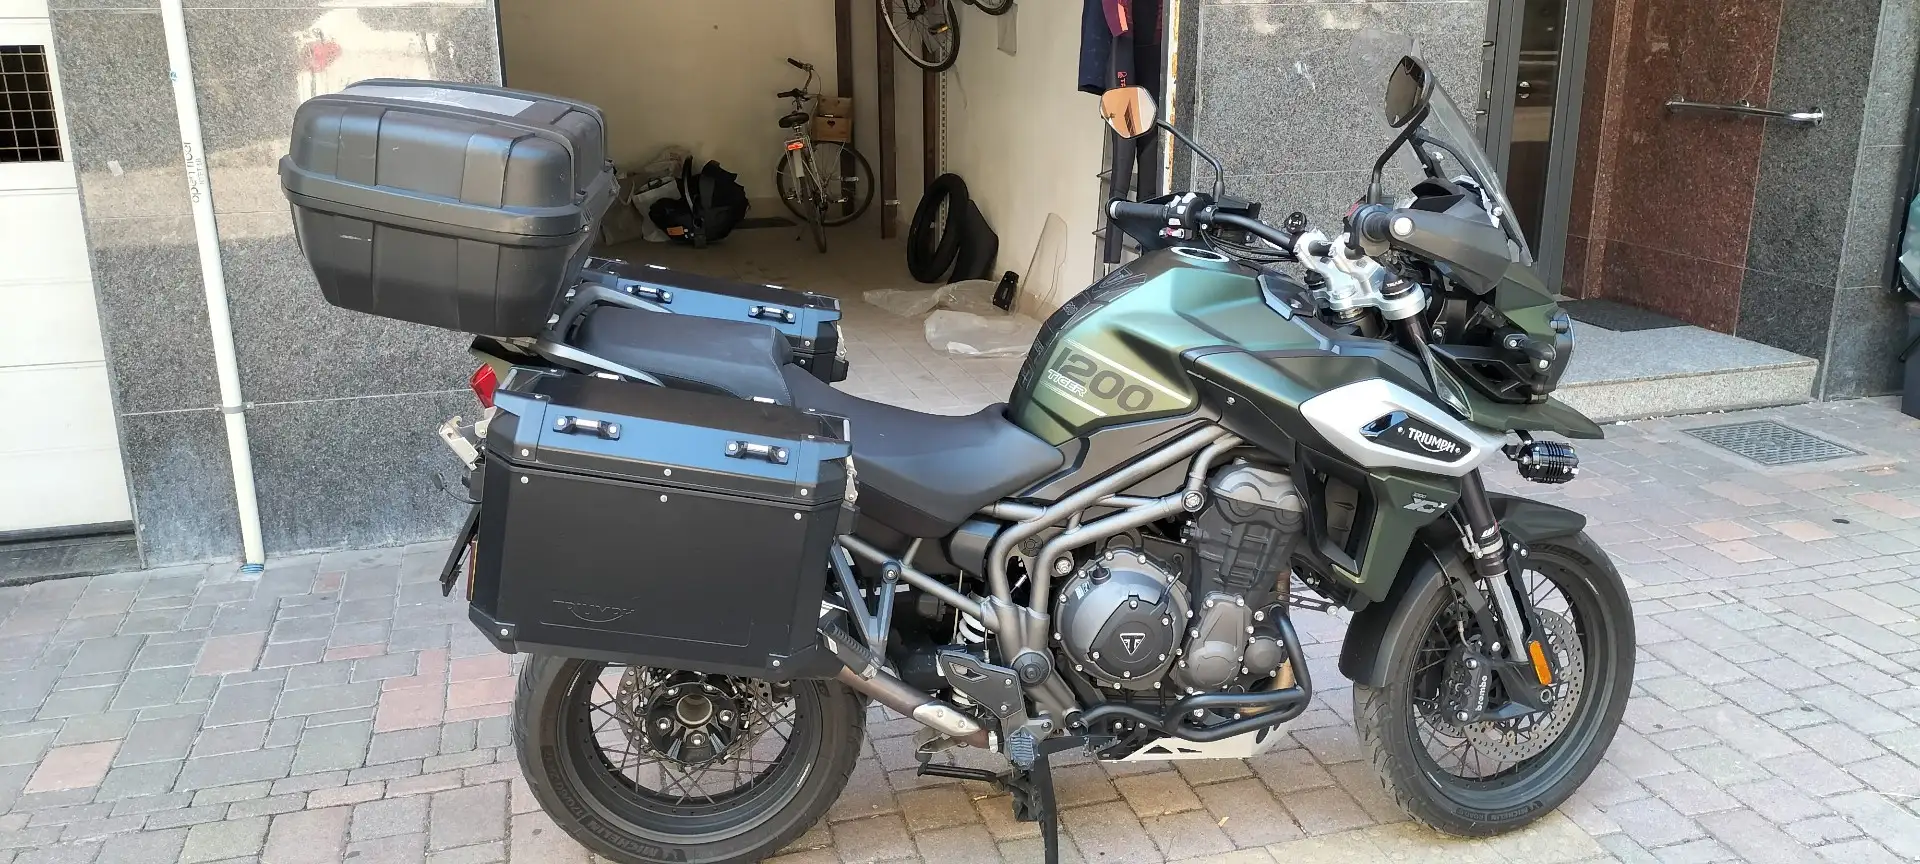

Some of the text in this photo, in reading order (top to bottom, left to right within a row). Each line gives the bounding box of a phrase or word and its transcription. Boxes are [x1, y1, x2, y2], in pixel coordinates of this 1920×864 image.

[1048, 369, 1088, 398] TIGER
[1050, 347, 1154, 412] 1200
[1408, 427, 1456, 454] TRIUMPH
[1475, 675, 1488, 711] brembo
[585, 818, 660, 859] MICHELIN
